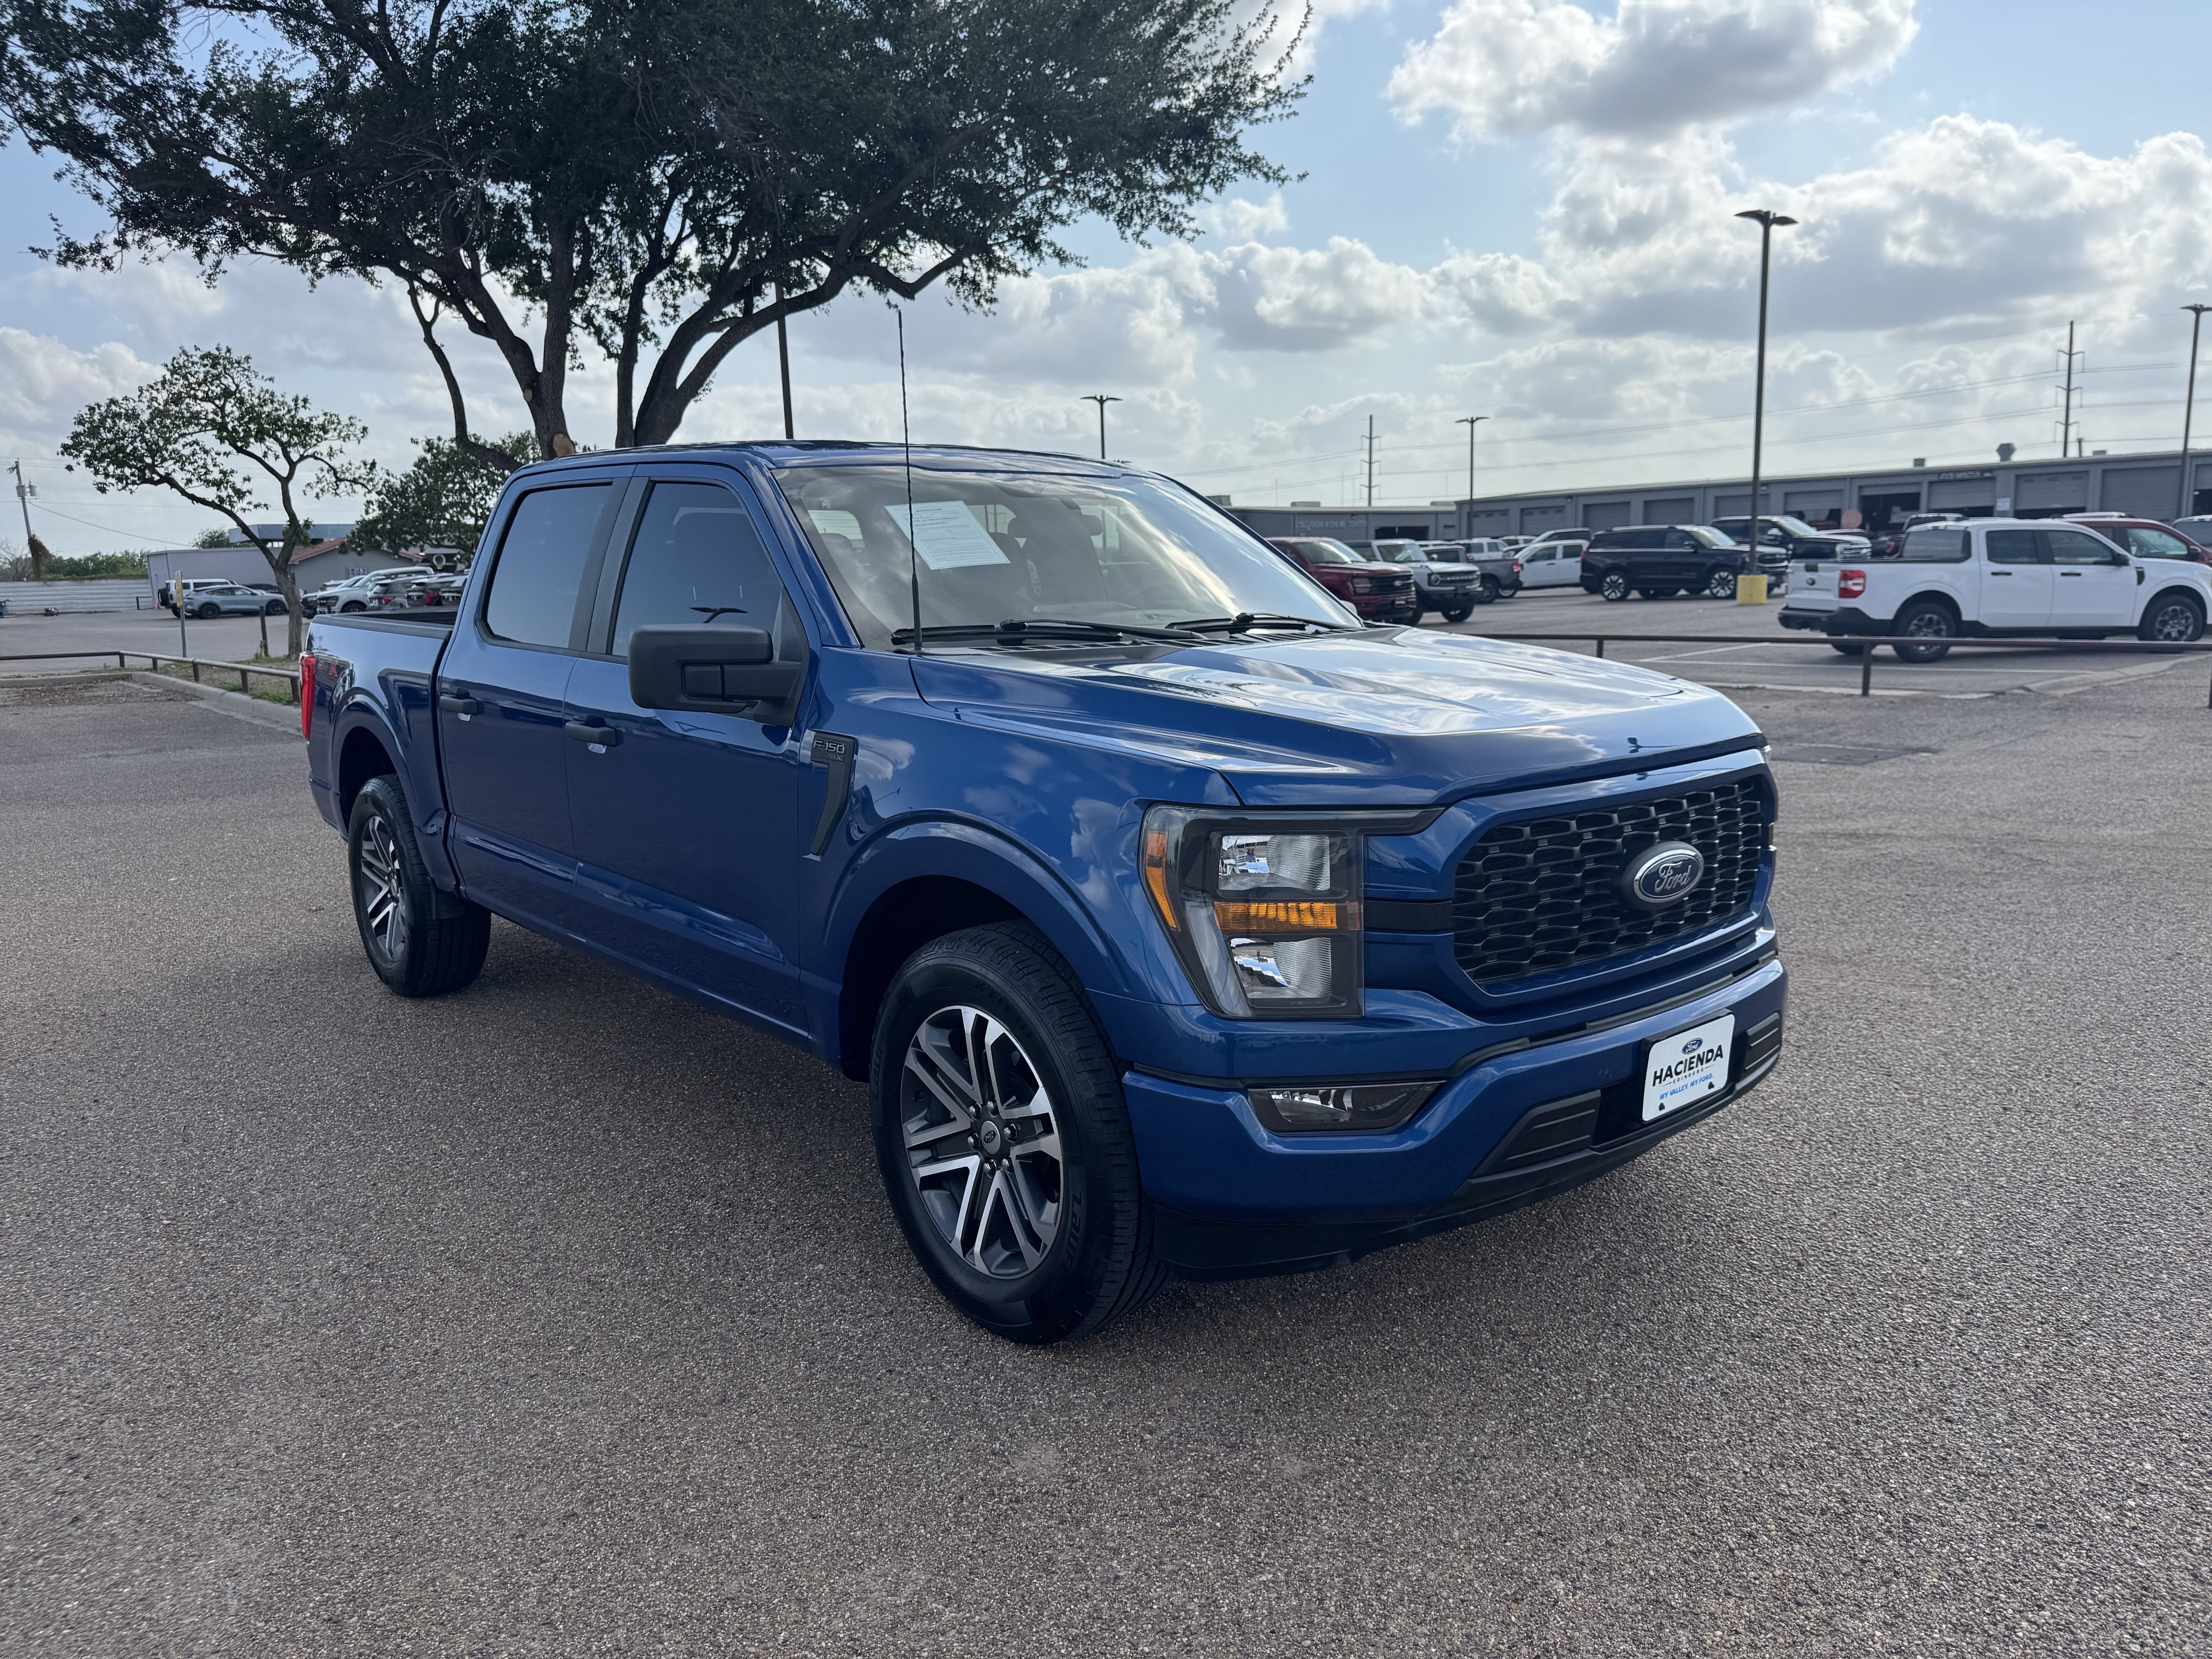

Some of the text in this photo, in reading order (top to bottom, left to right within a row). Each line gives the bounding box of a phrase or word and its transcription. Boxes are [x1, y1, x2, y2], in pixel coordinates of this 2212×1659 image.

[318, 658, 338, 677] STX
[813, 740, 845, 754] F-150
[1654, 861, 1692, 893] Ford
[1652, 1044, 1723, 1087] HACIENDA
[1673, 1067, 1704, 1084] EDINBURG
[1659, 1092, 1669, 1100] MY
[1690, 1079, 1699, 1087] MY
[1699, 1073, 1713, 1084] FORD.
